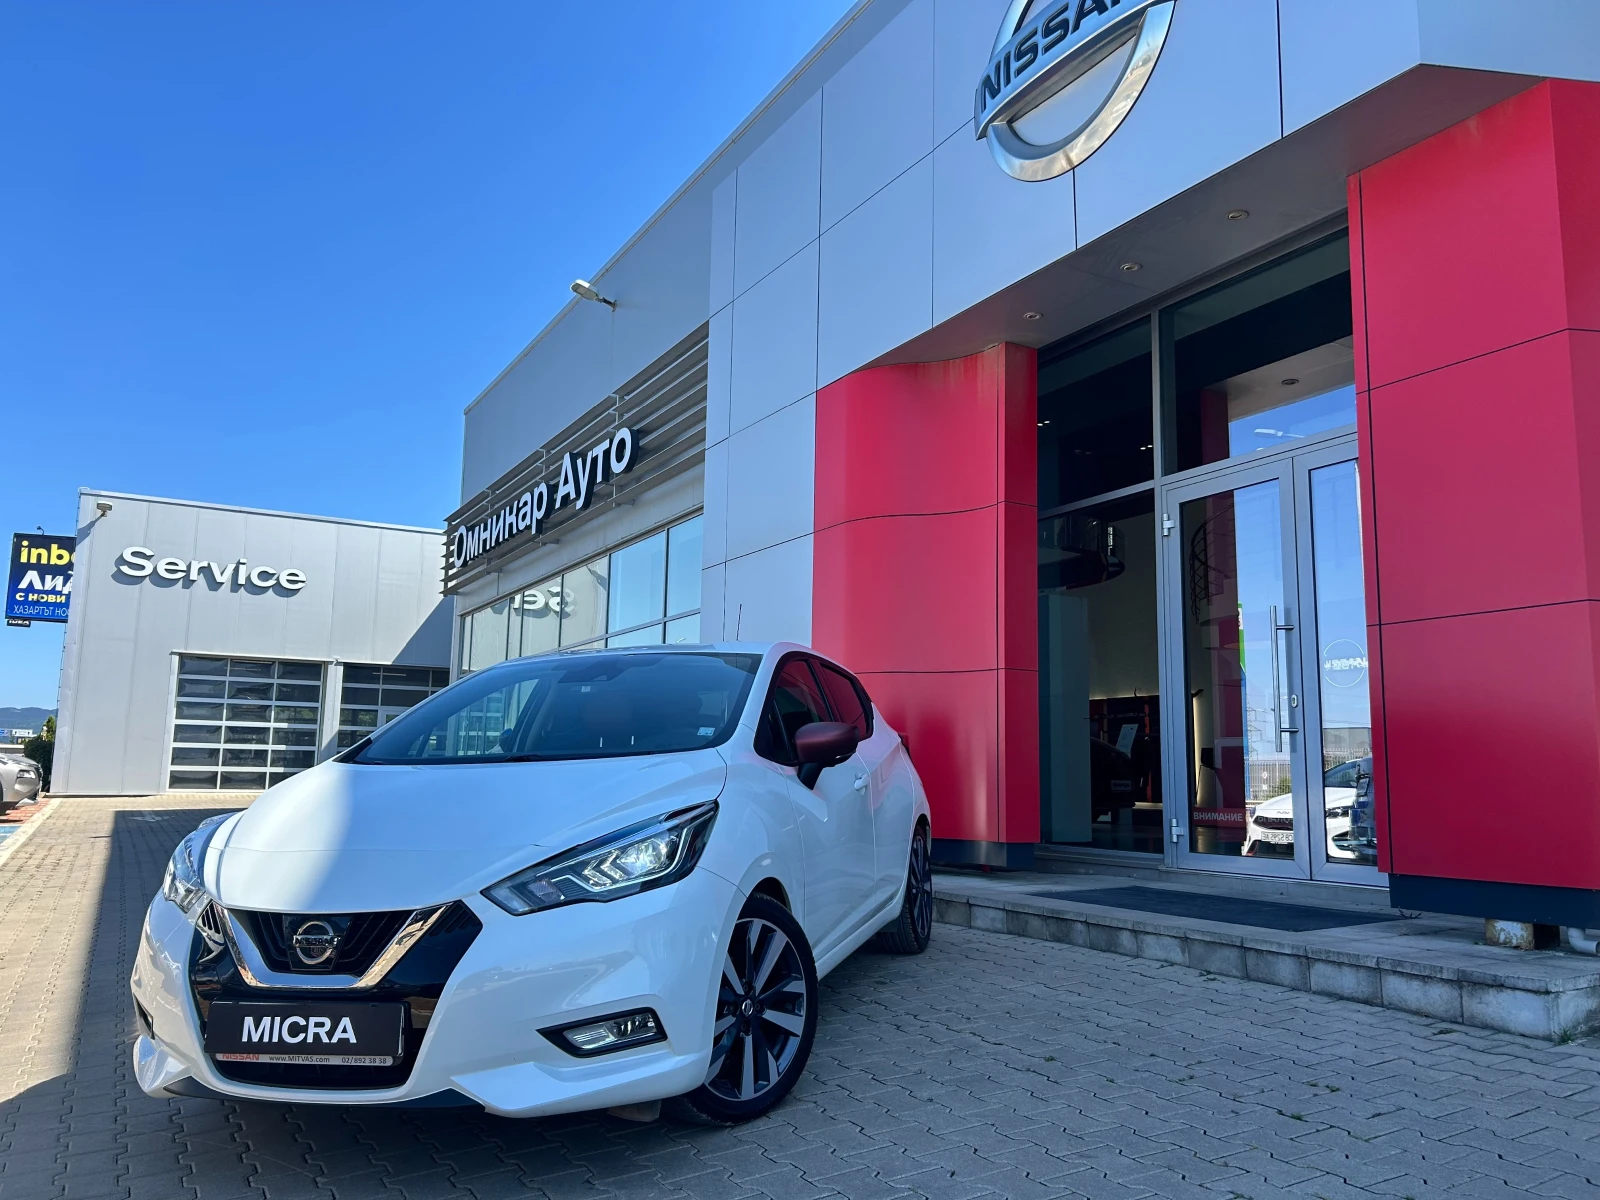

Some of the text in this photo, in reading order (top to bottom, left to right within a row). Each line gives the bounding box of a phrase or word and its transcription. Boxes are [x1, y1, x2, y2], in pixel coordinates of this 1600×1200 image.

[981, 0, 1120, 114] NISSA
[454, 427, 632, 568] Омникар Ауто
[20, 540, 75, 565] inb
[119, 546, 307, 590] Service
[1193, 811, 1243, 822] ВНИМАНИЕ
[241, 1016, 357, 1044] MICRA
[222, 1053, 260, 1061] NISSAN
[269, 1055, 330, 1063] www.MITVAS.com
